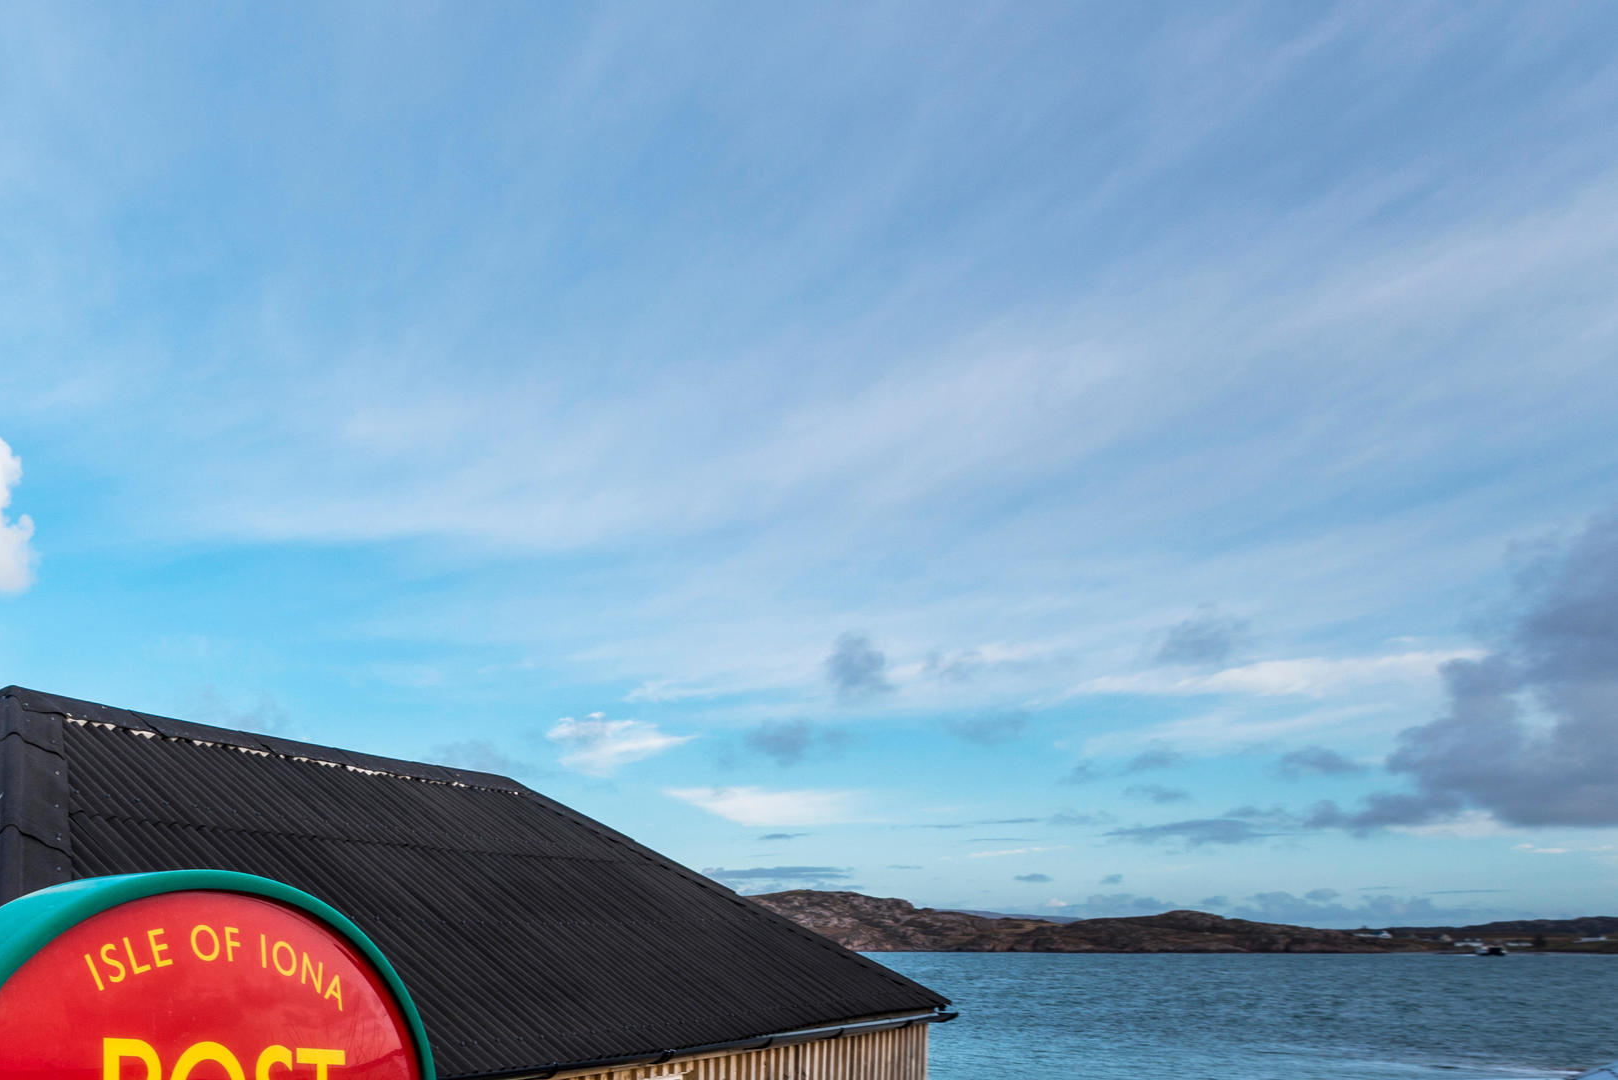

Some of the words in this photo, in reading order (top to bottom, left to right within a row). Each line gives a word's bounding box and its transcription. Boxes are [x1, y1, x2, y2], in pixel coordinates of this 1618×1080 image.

[83, 927, 174, 991] ISLE
[189, 924, 242, 963] OF
[260, 933, 344, 1011] IONA
